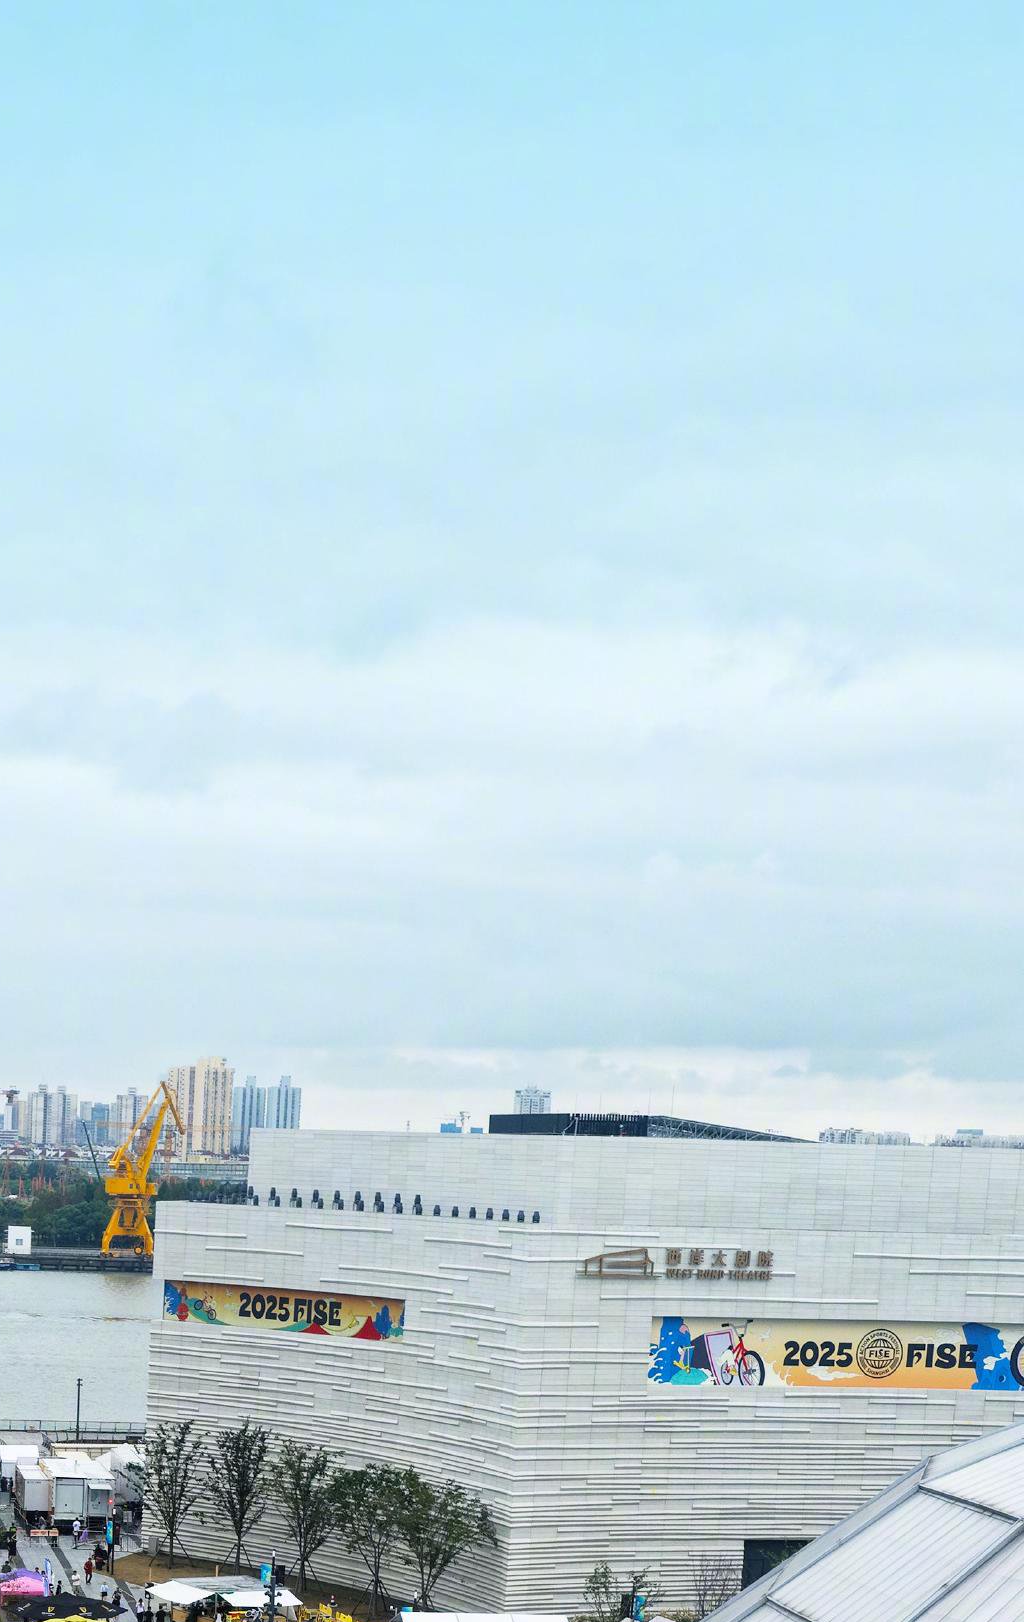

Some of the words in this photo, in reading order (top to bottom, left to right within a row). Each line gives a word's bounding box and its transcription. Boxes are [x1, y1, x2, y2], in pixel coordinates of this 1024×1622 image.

[239, 1292, 291, 1323] 2025
[293, 1297, 343, 1327] FISE
[784, 1340, 853, 1368] 2025
[869, 1348, 890, 1359] FISE
[906, 1343, 979, 1369] FISE
